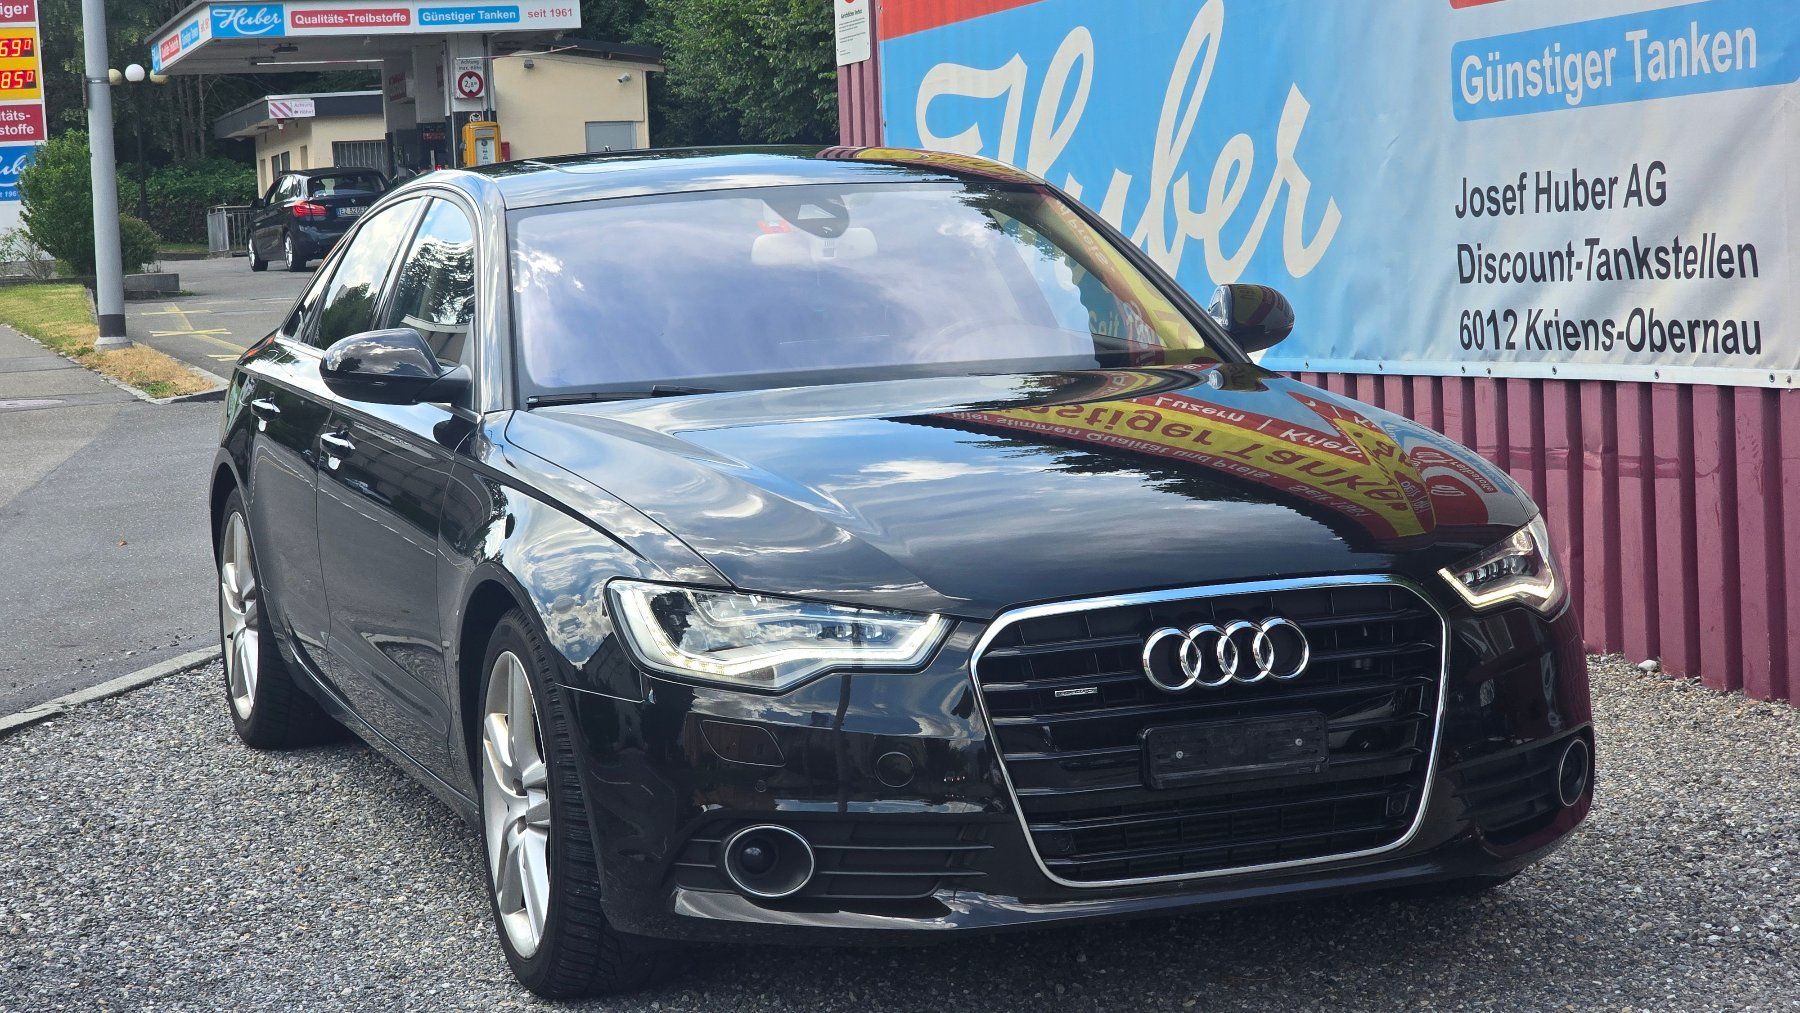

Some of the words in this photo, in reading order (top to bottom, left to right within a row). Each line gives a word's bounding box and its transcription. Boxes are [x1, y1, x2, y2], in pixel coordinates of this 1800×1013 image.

[0, 2, 29, 18] iger
[422, 10, 476, 23] Günstiger
[477, 10, 516, 20] Tanken
[527, 9, 547, 18] seit
[549, 8, 573, 18] 1961
[212, 7, 282, 35] Huber
[294, 12, 407, 25] Qualitäts-Treibstoffe
[1460, 42, 1616, 106] Günstiger
[1625, 21, 1757, 84] Tanken
[0, 110, 31, 121] täts-
[0, 124, 34, 135] stoffe
[1455, 171, 1527, 219] Josef
[1535, 167, 1618, 214] Huber
[1623, 160, 1667, 209] AG
[1457, 232, 1759, 285] Discount-Tankstellen
[1459, 308, 1518, 351] 6012
[1525, 307, 1762, 356] Kriens-Obernau
